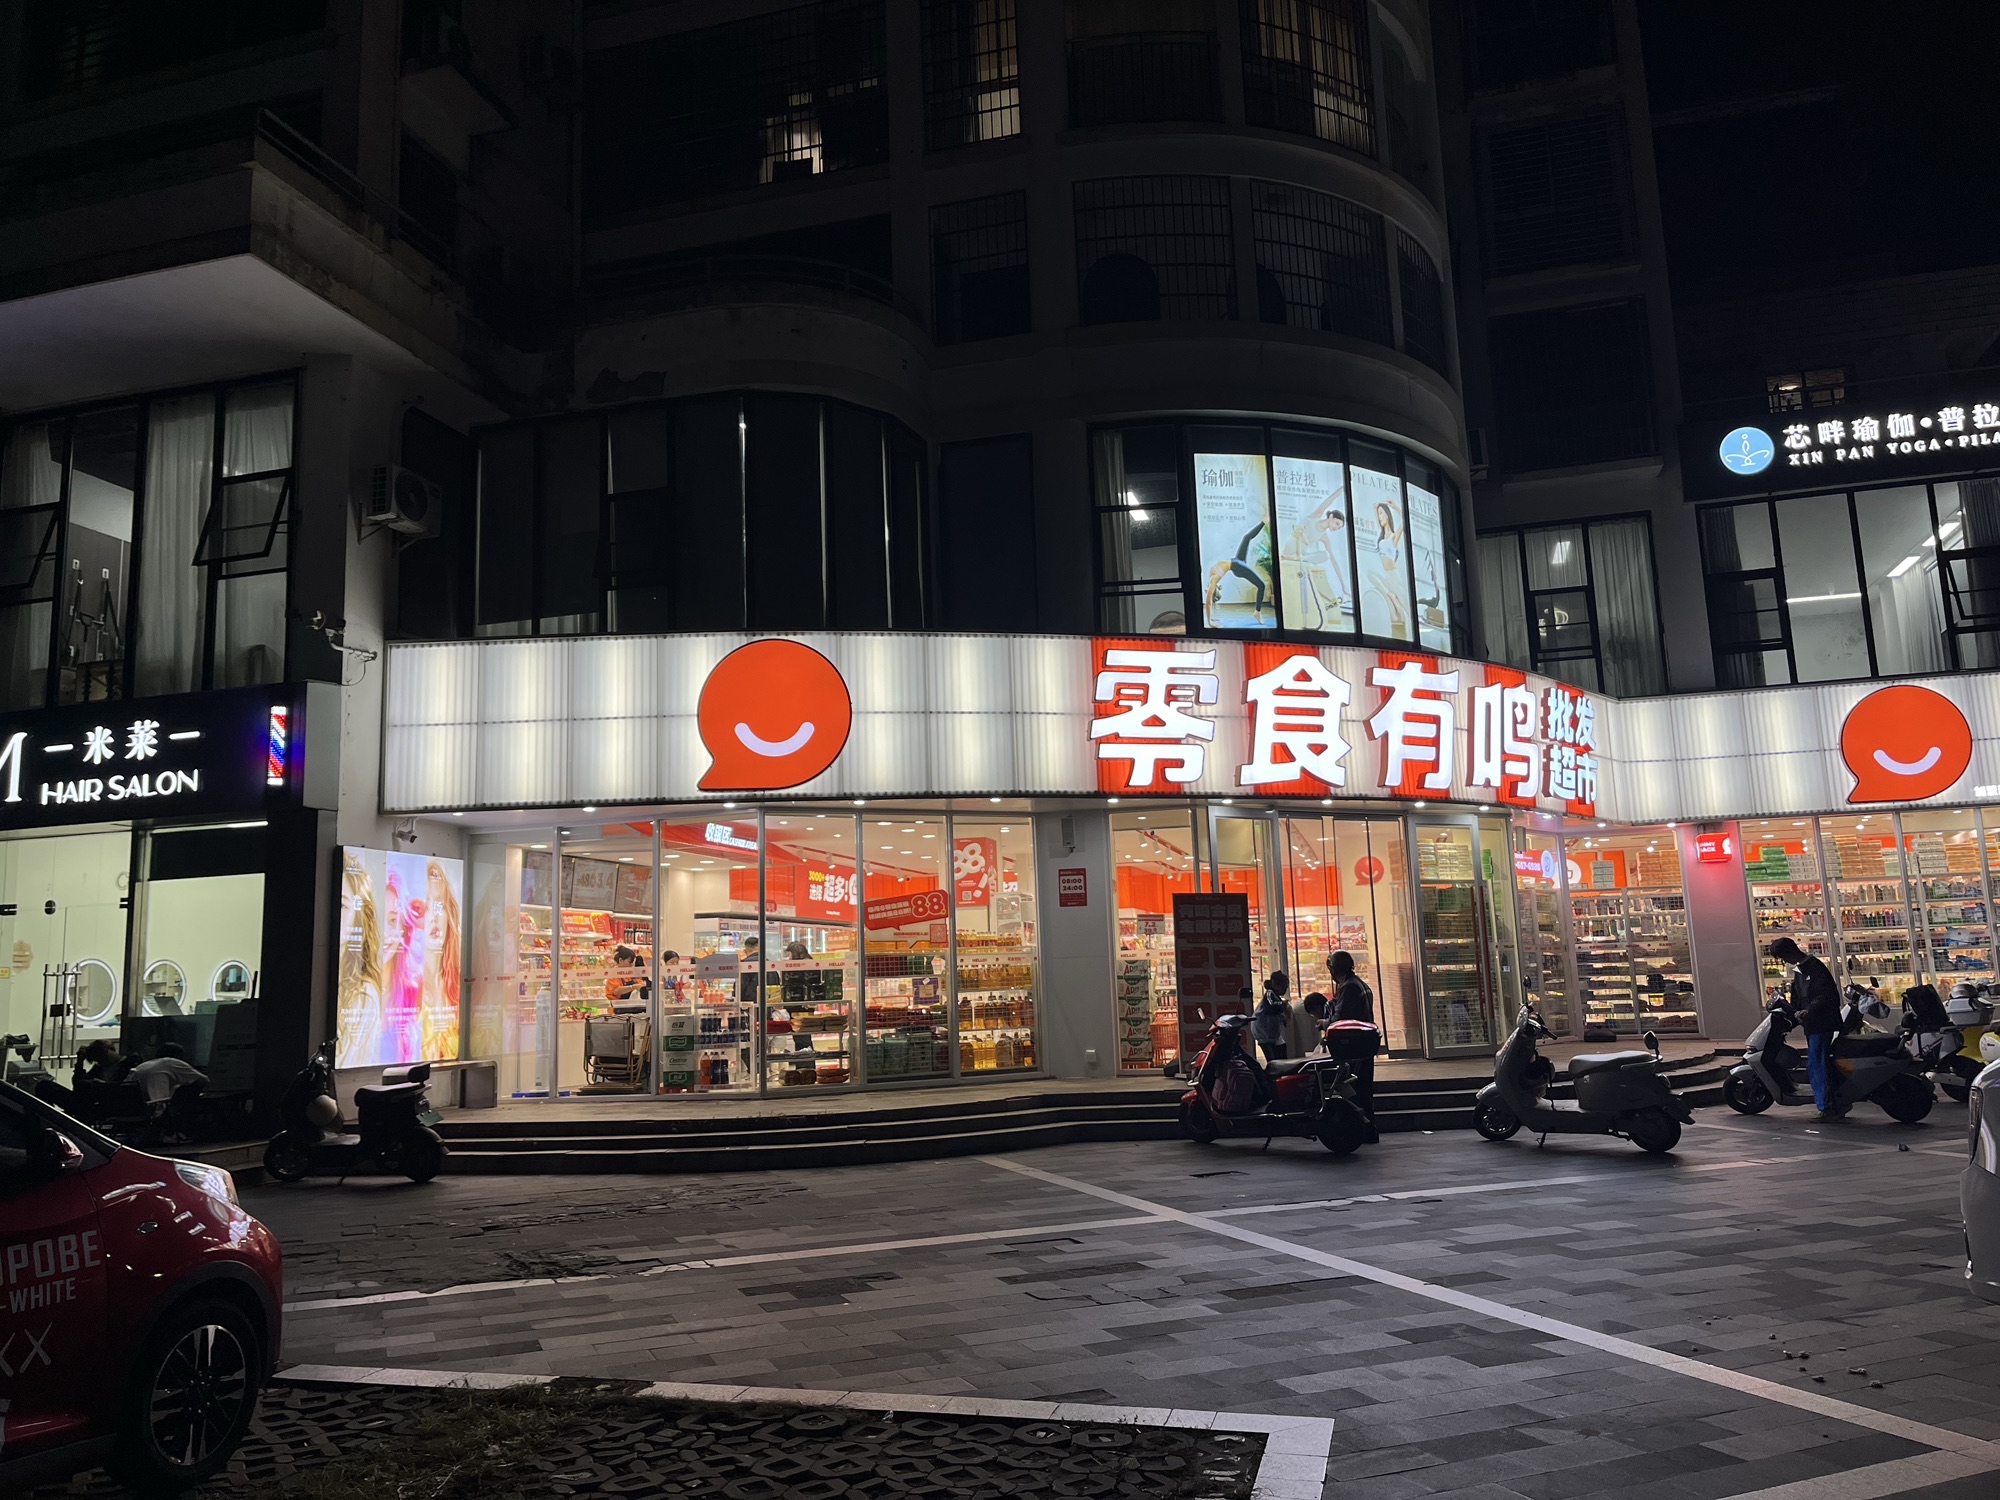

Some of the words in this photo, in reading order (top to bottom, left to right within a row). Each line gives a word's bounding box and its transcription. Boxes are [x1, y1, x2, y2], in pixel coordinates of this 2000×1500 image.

[1788, 451, 1823, 467] XIN
[1836, 447, 1874, 462] PAN
[1202, 468, 1234, 488] 瑜伽
[1276, 469, 1317, 488] 普拉提
[1088, 649, 1540, 798] 零食有鸣
[1542, 687, 1596, 752] 批发
[41, 778, 104, 806] HAIR
[107, 768, 200, 800] SALON
[1545, 746, 1598, 805] 超市
[809, 883, 823, 901] 选择
